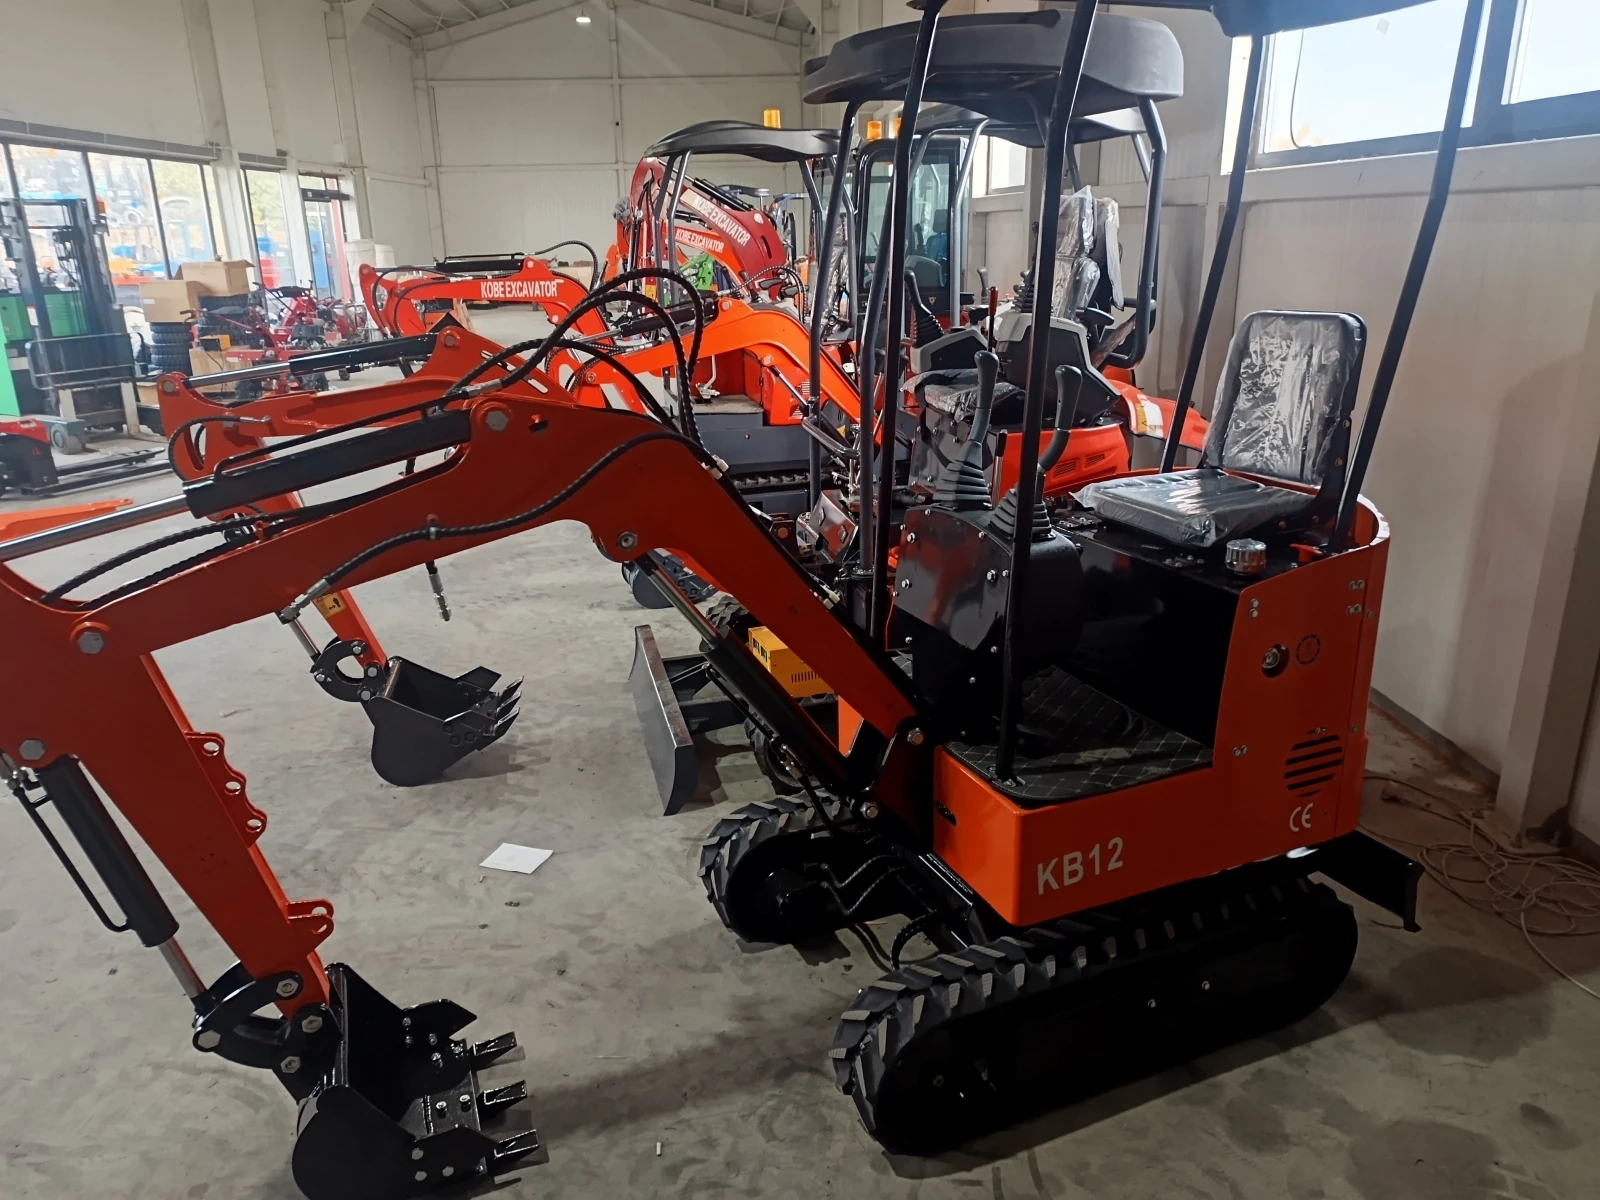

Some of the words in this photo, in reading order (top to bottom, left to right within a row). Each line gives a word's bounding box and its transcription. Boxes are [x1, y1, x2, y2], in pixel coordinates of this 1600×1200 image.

[693, 196, 713, 218] KOBE
[711, 207, 751, 247] EXCAVATOR
[675, 228, 691, 243] KOBE
[690, 233, 725, 253] EXCAVATOR
[480, 281, 505, 298] KOBE
[505, 280, 558, 298] EXCAVATOR
[1289, 802, 1314, 832] CE
[1037, 836, 1124, 896] KB12
